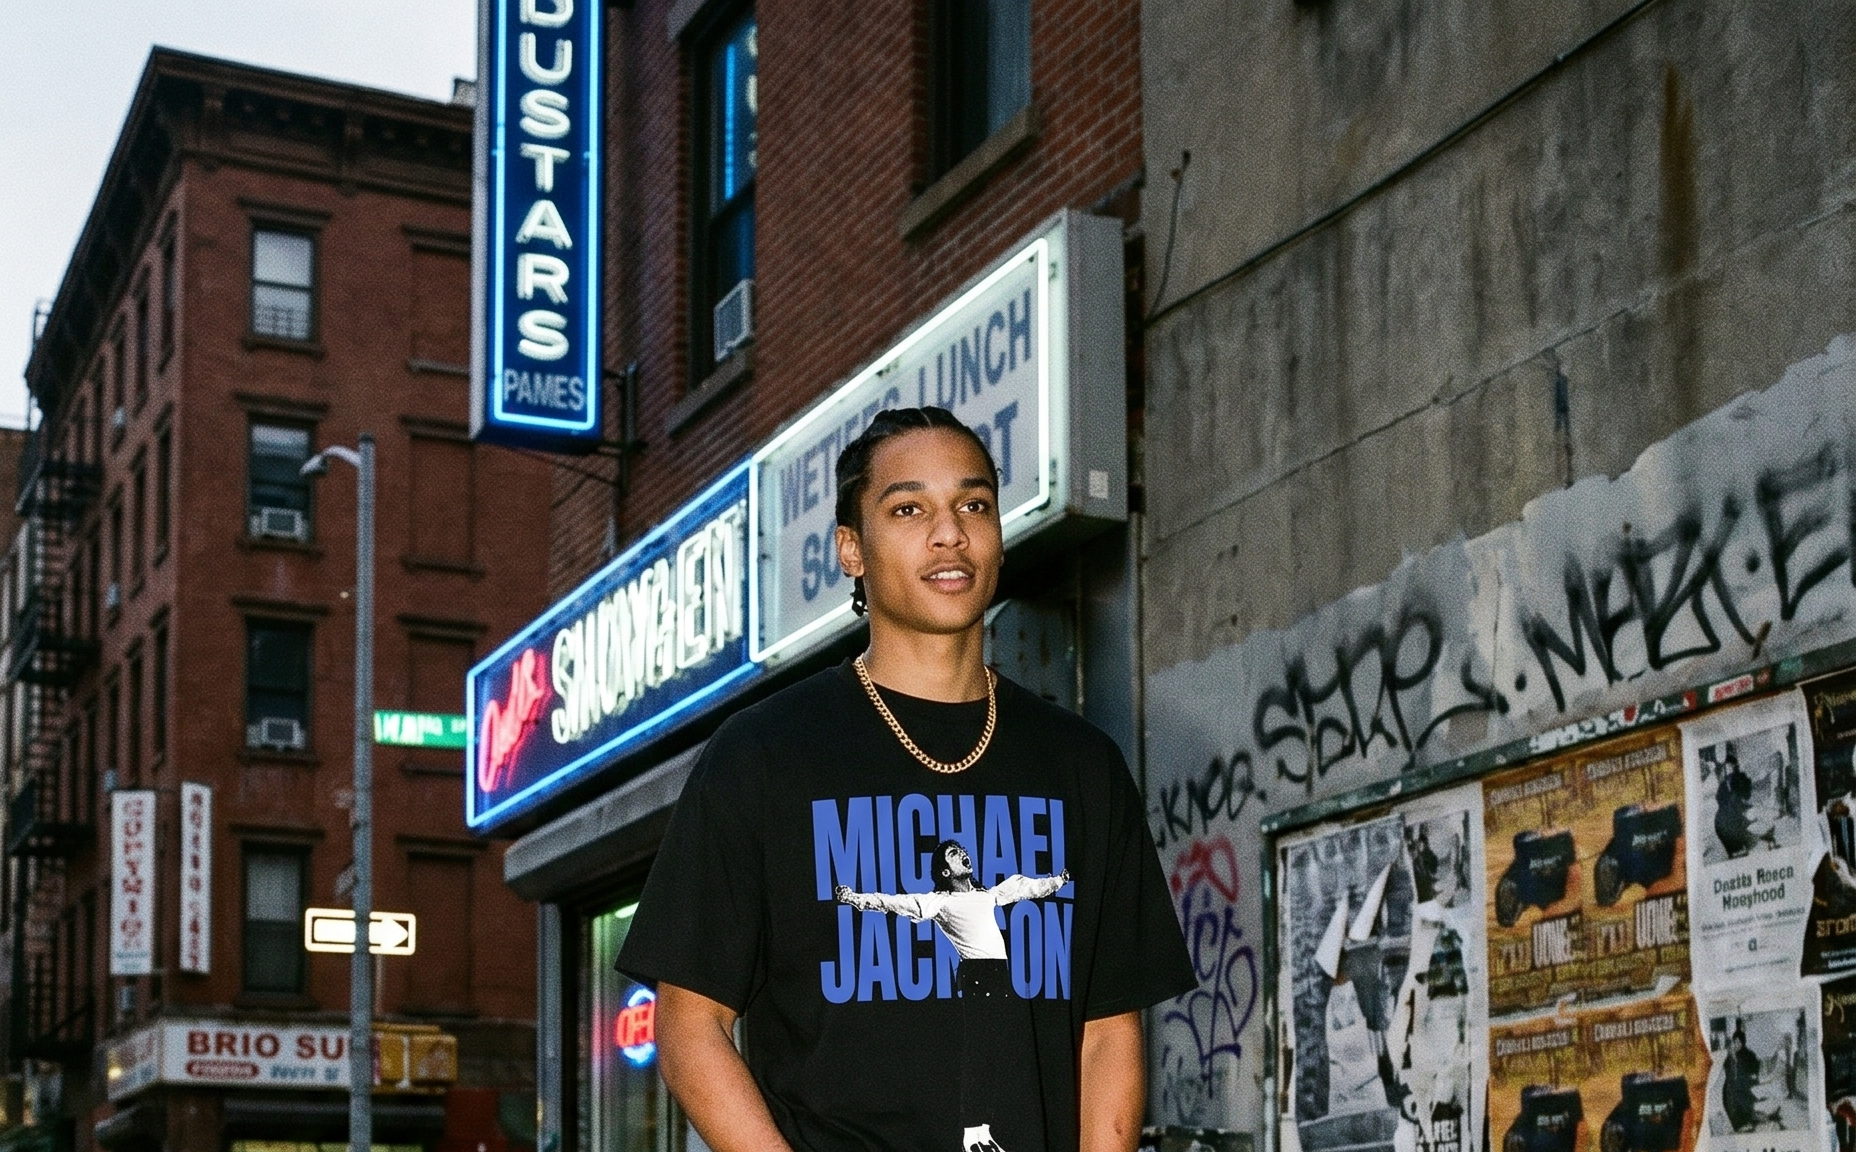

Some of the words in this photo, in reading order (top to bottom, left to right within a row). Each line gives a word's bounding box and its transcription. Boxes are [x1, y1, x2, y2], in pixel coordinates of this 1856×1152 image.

[811, 793, 1075, 901] MICHAEL
[819, 898, 1075, 1005] JACKON
[187, 1030, 280, 1059] BRIO
